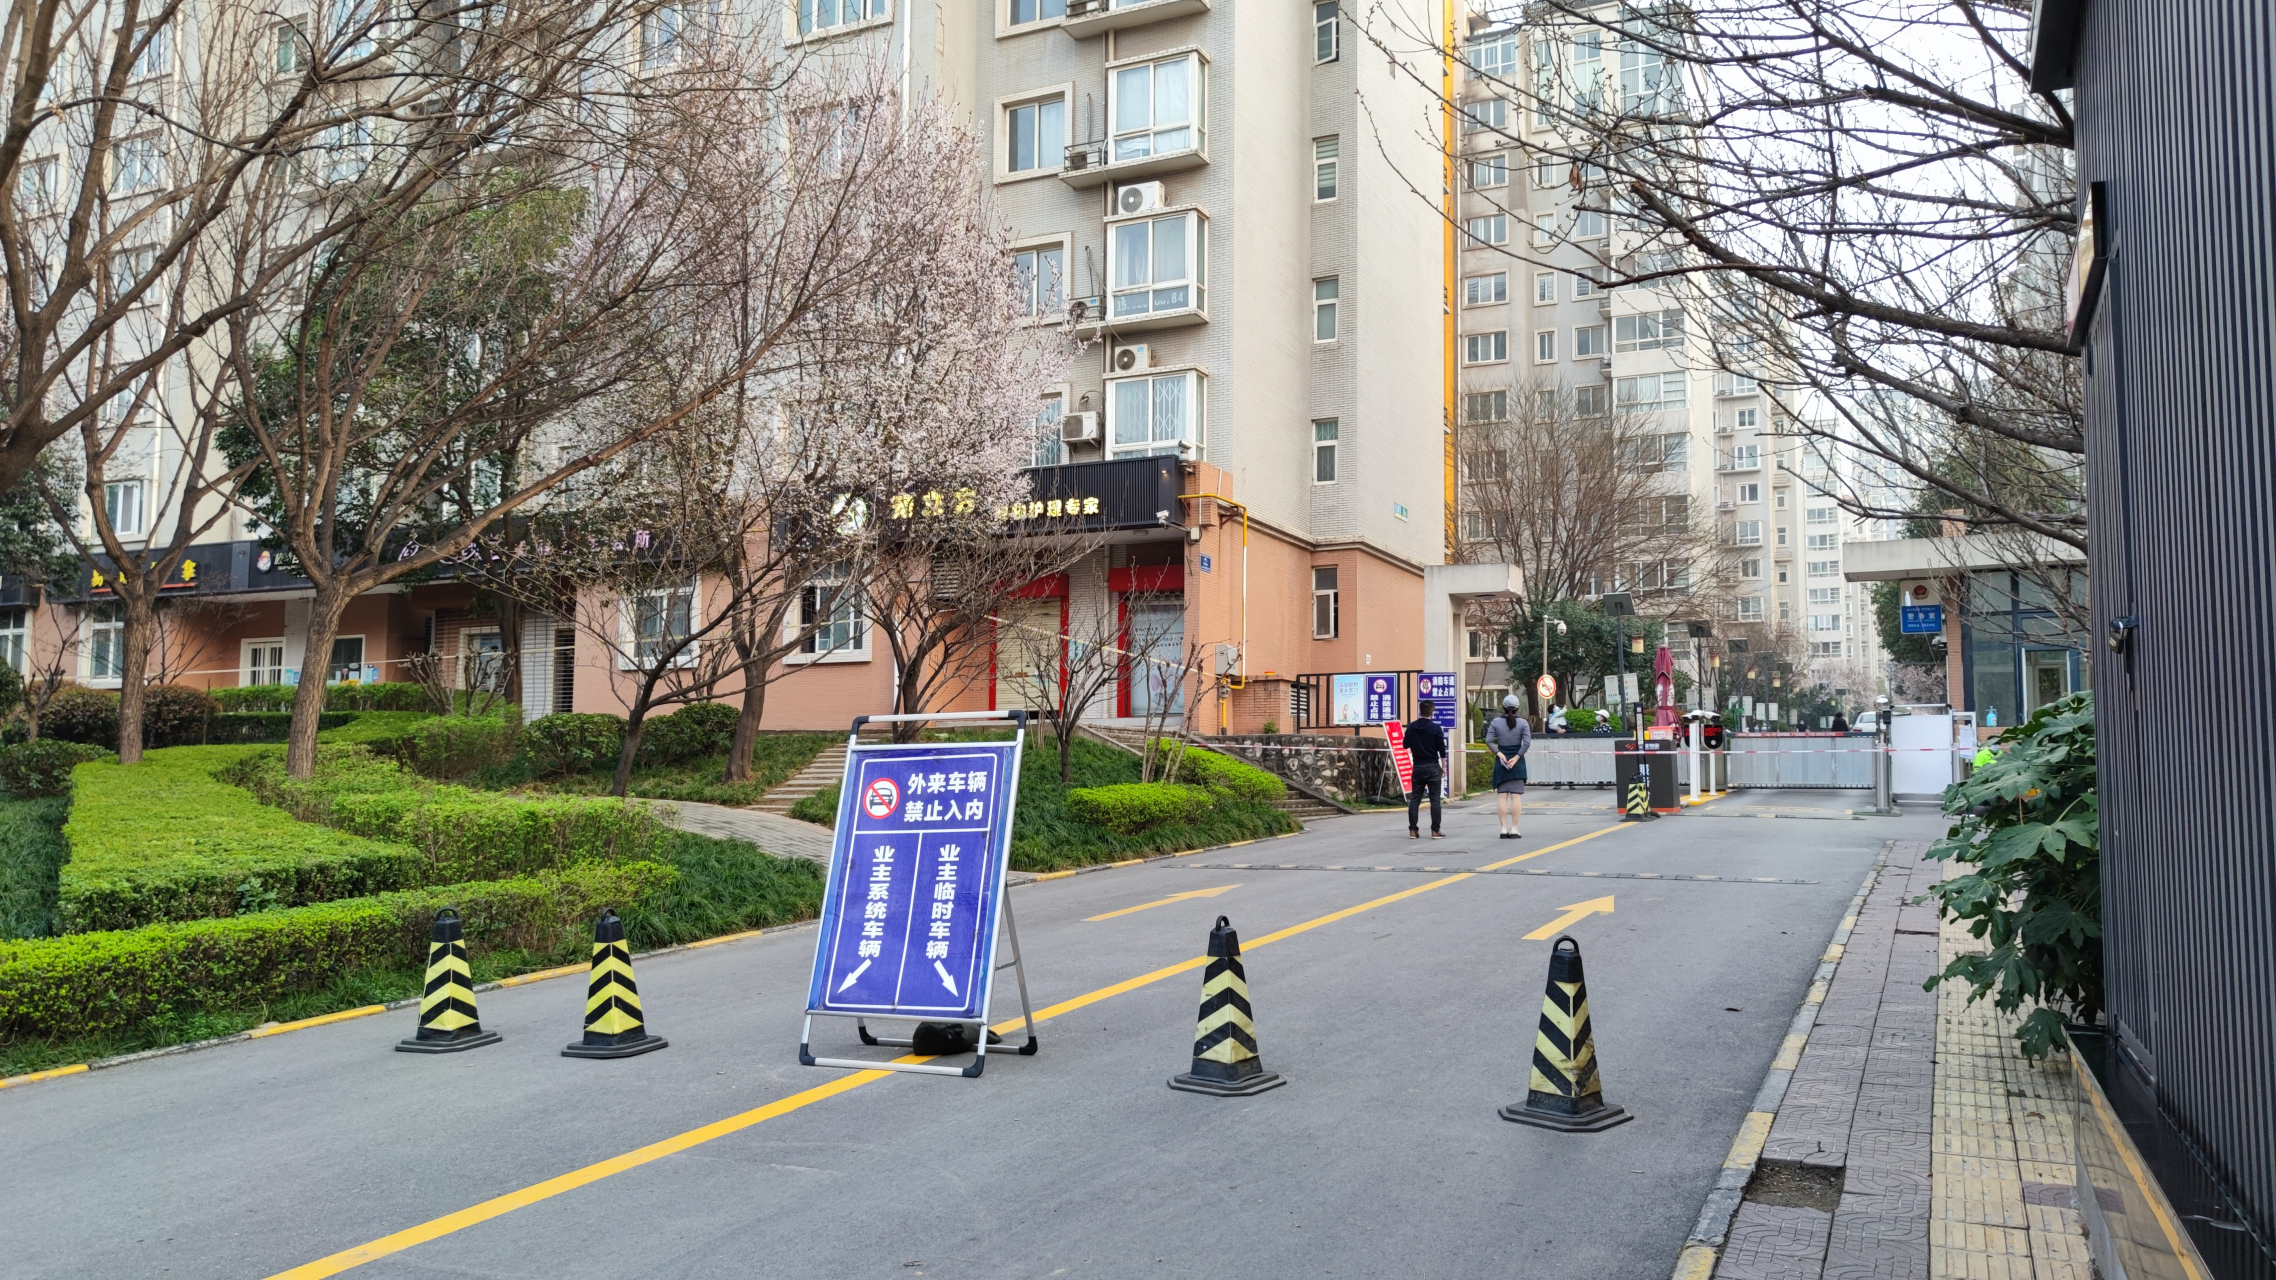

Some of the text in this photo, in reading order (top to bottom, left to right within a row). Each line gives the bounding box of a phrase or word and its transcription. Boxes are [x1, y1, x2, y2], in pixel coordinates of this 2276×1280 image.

[1432, 688, 1454, 696] 禁止占用
[1370, 694, 1379, 719] 禁止占用
[908, 771, 987, 794] 外来车辆
[904, 799, 983, 822] 禁止入内
[858, 845, 895, 958] 业主系统车辆
[926, 844, 960, 959] 业主临时车辆
